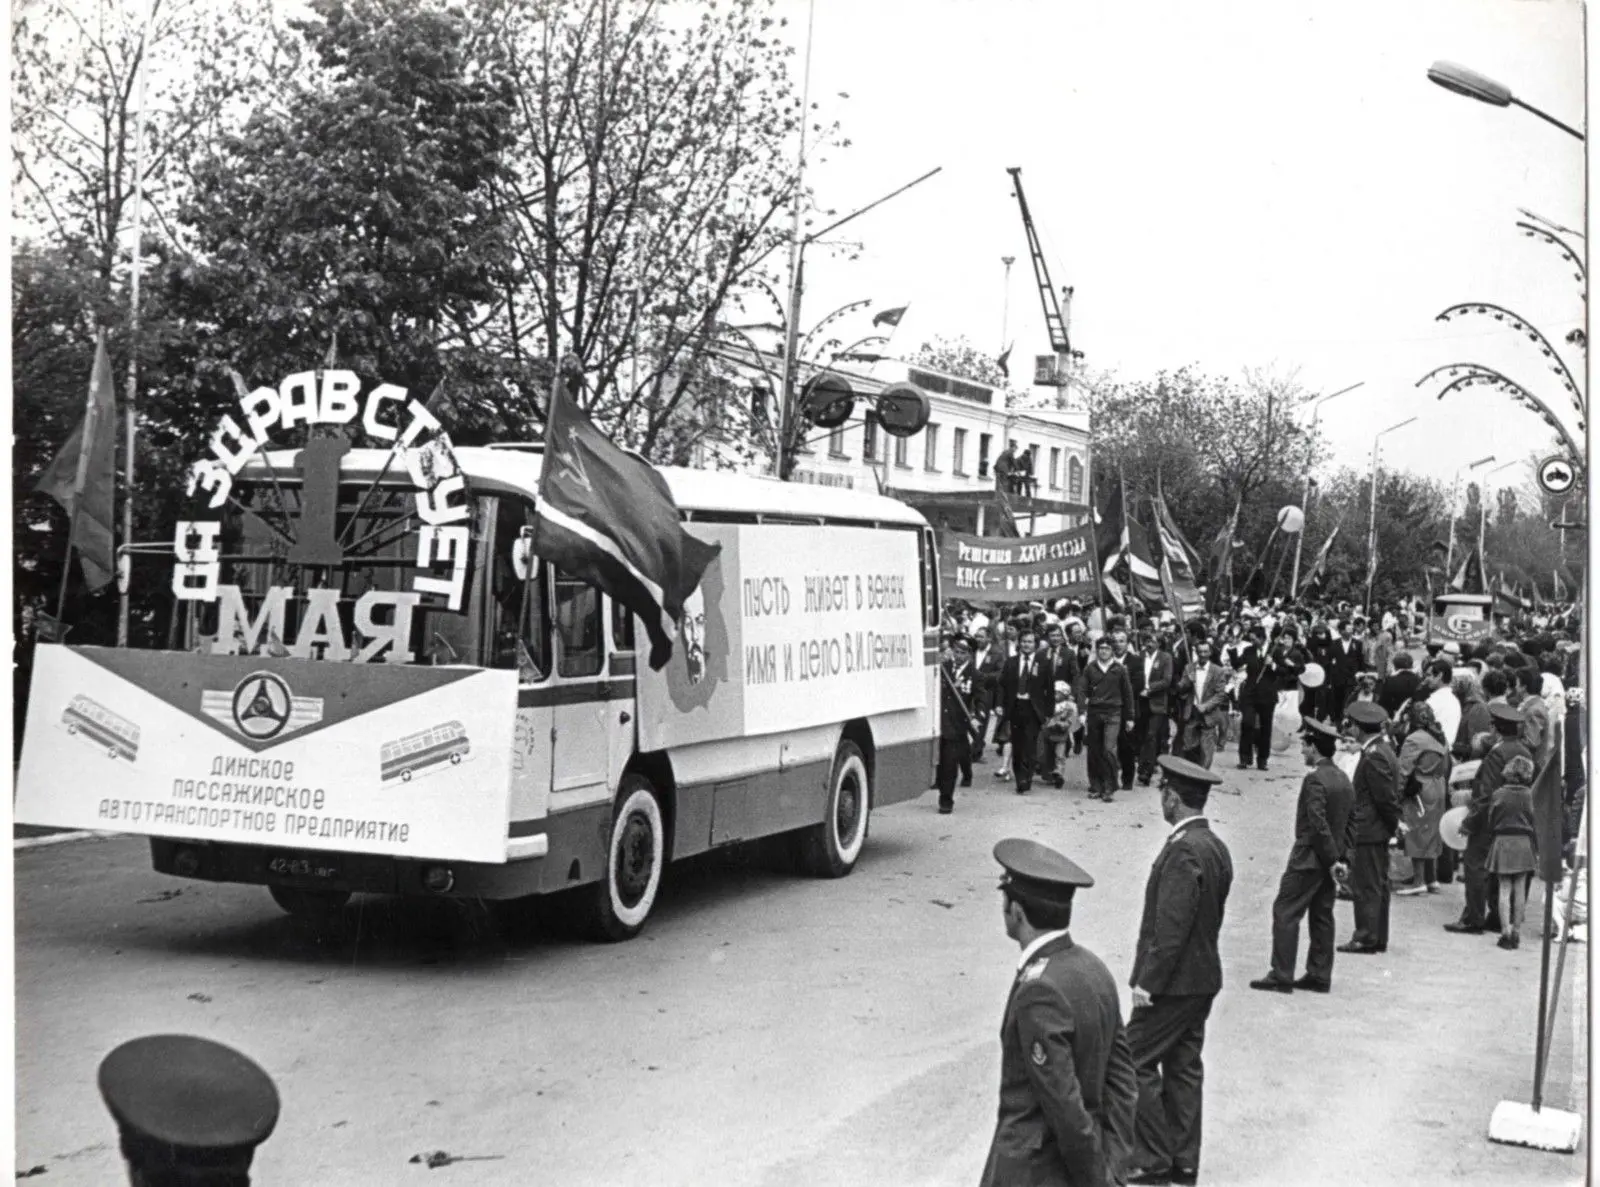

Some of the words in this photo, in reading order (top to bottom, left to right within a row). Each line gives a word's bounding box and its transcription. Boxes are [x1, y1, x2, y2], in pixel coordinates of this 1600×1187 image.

[287, 436, 352, 565] 1
[172, 521, 221, 602] ДА
[956, 566, 988, 590] КПСС
[743, 576, 790, 617] ПУСТЬ
[804, 575, 849, 613] ЖИВЕТ
[855, 574, 863, 611] В
[867, 574, 907, 610] ВЕКАХ
[208, 584, 421, 664] МАЯ
[745, 643, 777, 685] ИМЯ
[783, 642, 793, 682] И
[799, 637, 841, 682] ДЕЛО
[210, 755, 295, 782] ДИНСКОЕ
[172, 778, 326, 810] ПАССАЖИРСКОЕ
[98, 798, 276, 832] АВТОТРАНСПОРТНОЕ
[284, 813, 410, 843] ПРЕДПРИЯТИЕ
